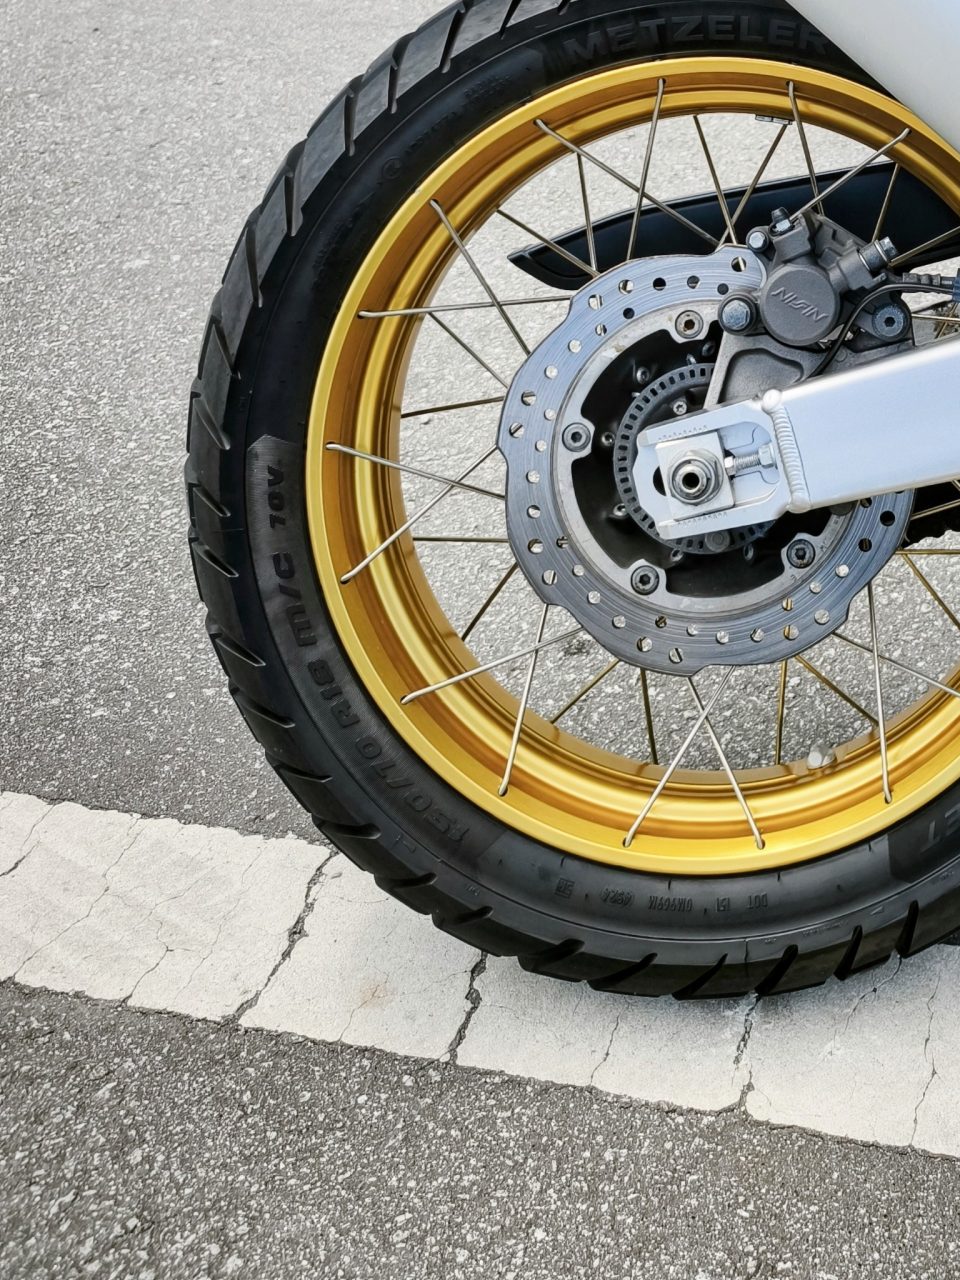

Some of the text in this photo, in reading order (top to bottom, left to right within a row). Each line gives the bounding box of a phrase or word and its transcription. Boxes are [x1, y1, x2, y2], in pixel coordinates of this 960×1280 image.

[562, 14, 832, 62] METZELER
[267, 464, 286, 529] 70V
[307, 658, 361, 728] R18
